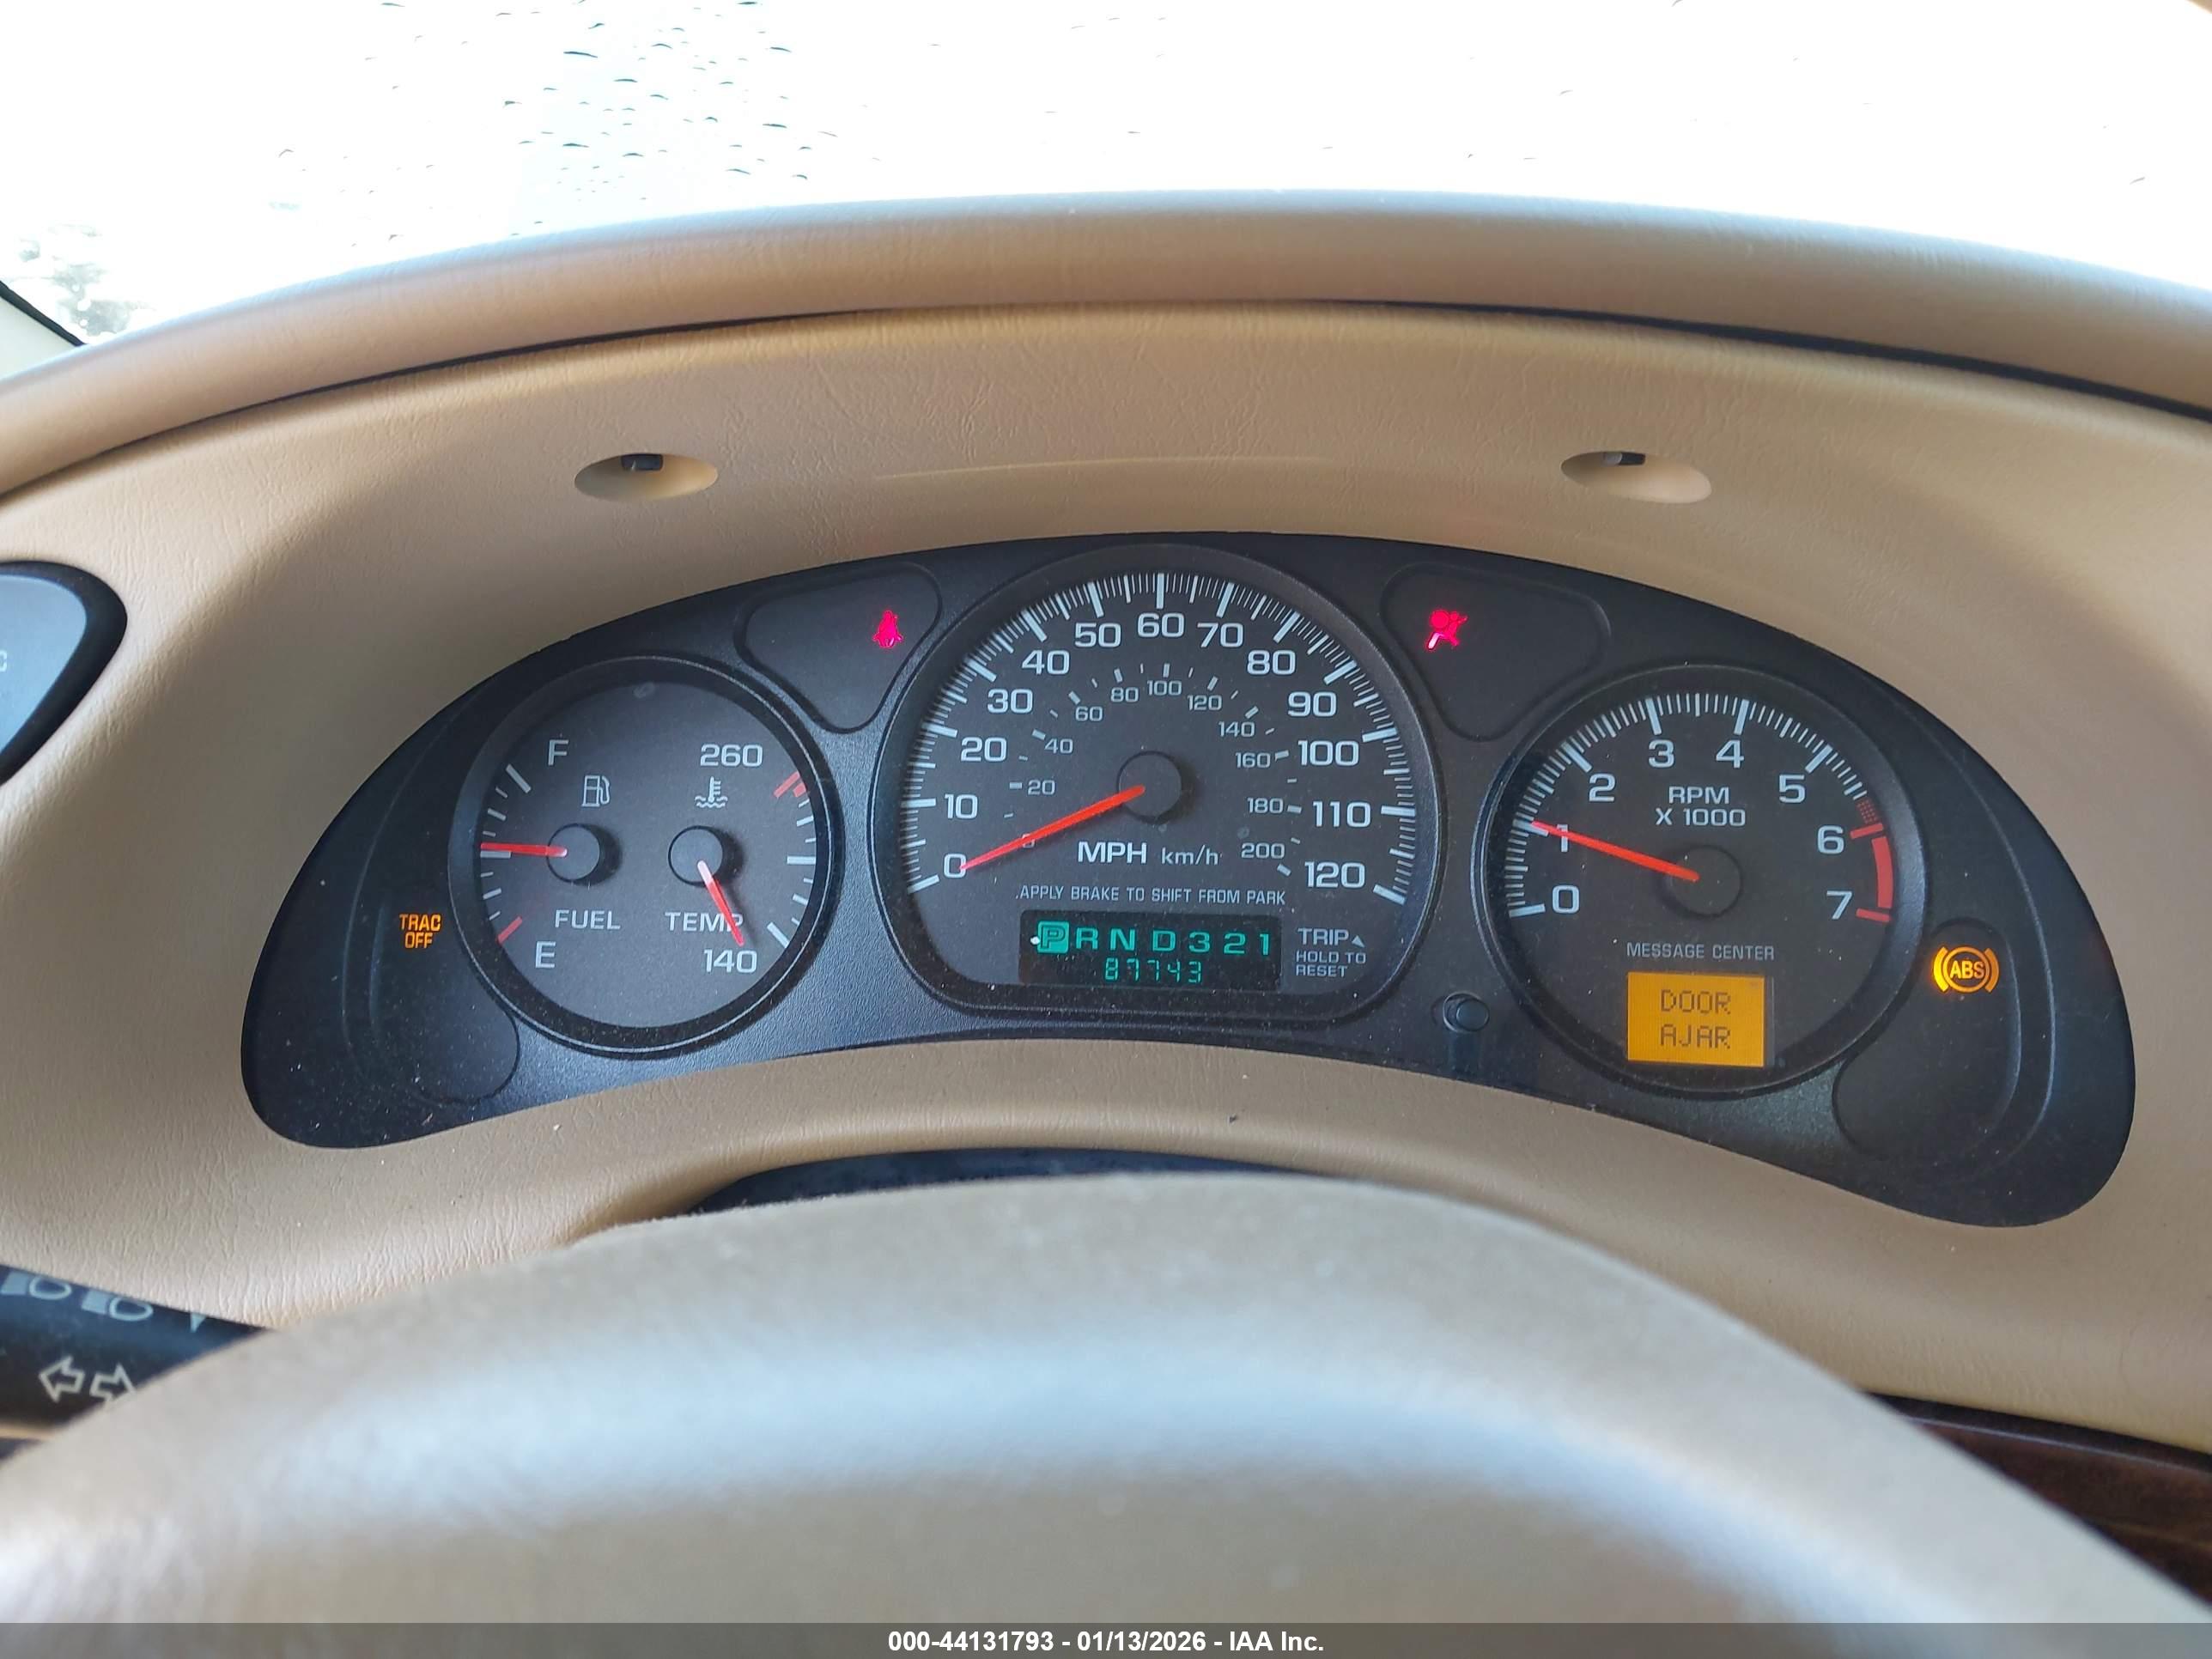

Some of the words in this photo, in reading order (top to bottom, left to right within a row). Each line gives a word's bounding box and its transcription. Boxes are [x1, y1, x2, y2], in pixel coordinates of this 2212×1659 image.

[1075, 623, 1121, 647] 50
[1138, 613, 1184, 638] 60
[1197, 623, 1243, 647] 70
[1022, 650, 1070, 675] 40
[1247, 650, 1296, 675] 80
[1110, 688, 1139, 702] 80
[1146, 680, 1182, 696] 100
[988, 690, 1033, 714] 30
[1188, 695, 1222, 710] 120
[1288, 691, 1337, 717] 90
[1075, 707, 1103, 722] 60
[1218, 721, 1255, 737] 140
[547, 739, 569, 766] F
[700, 744, 763, 768] 260
[960, 737, 1007, 762] 20
[1044, 738, 1073, 754] 40
[1297, 740, 1359, 766] 100
[1648, 740, 1674, 769] 3
[1716, 741, 1744, 769] 4
[1236, 751, 1271, 769] 160
[1027, 780, 1055, 795] 20
[1589, 773, 1615, 802] 2
[1668, 787, 1729, 805] RPM
[1778, 775, 1806, 804] 5
[945, 793, 978, 819] 10
[1247, 799, 1284, 814] 180
[1312, 801, 1371, 828] 110
[1656, 808, 1673, 826] X
[1682, 808, 1746, 827] 1000
[1557, 824, 1569, 852] 1
[1817, 826, 1844, 854] 6
[1078, 842, 1146, 864] MPH
[1161, 845, 1218, 866] km/h
[1241, 842, 1285, 859] 200
[944, 854, 966, 878] 0
[1304, 861, 1366, 888] 120
[1020, 885, 1064, 900] APPLY
[1072, 886, 1119, 901] BRAKE
[1127, 887, 1145, 902] TO
[1152, 888, 1192, 902] SHIFT
[1199, 890, 1240, 903] FROM
[1247, 890, 1285, 905] PARK
[1553, 885, 1580, 914] 0
[1826, 890, 1853, 920] 7
[399, 914, 441, 932] TRAC
[555, 910, 621, 930] FUEL
[665, 912, 744, 933] TEMP
[404, 932, 433, 949] OFF
[1040, 924, 1066, 950] P
[1076, 927, 1098, 950] R
[1110, 928, 1135, 951] N
[1152, 930, 1176, 952] D
[1188, 932, 1211, 953] 3
[1224, 933, 1245, 955] 2
[1259, 933, 1270, 956] 1
[1297, 927, 1349, 945] TRIP
[535, 941, 556, 969] E
[703, 950, 757, 973] 140
[1295, 951, 1339, 963] HOLD
[1346, 952, 1366, 964] TO
[1626, 942, 1704, 958] MESSAGE
[1712, 945, 1775, 960] CENTER
[1105, 957, 1201, 983] 87743
[1295, 964, 1347, 977] RESET
[1949, 960, 1985, 979] ABS
[1661, 989, 1730, 1015] DOOR
[1661, 1023, 1730, 1049] AJAR
